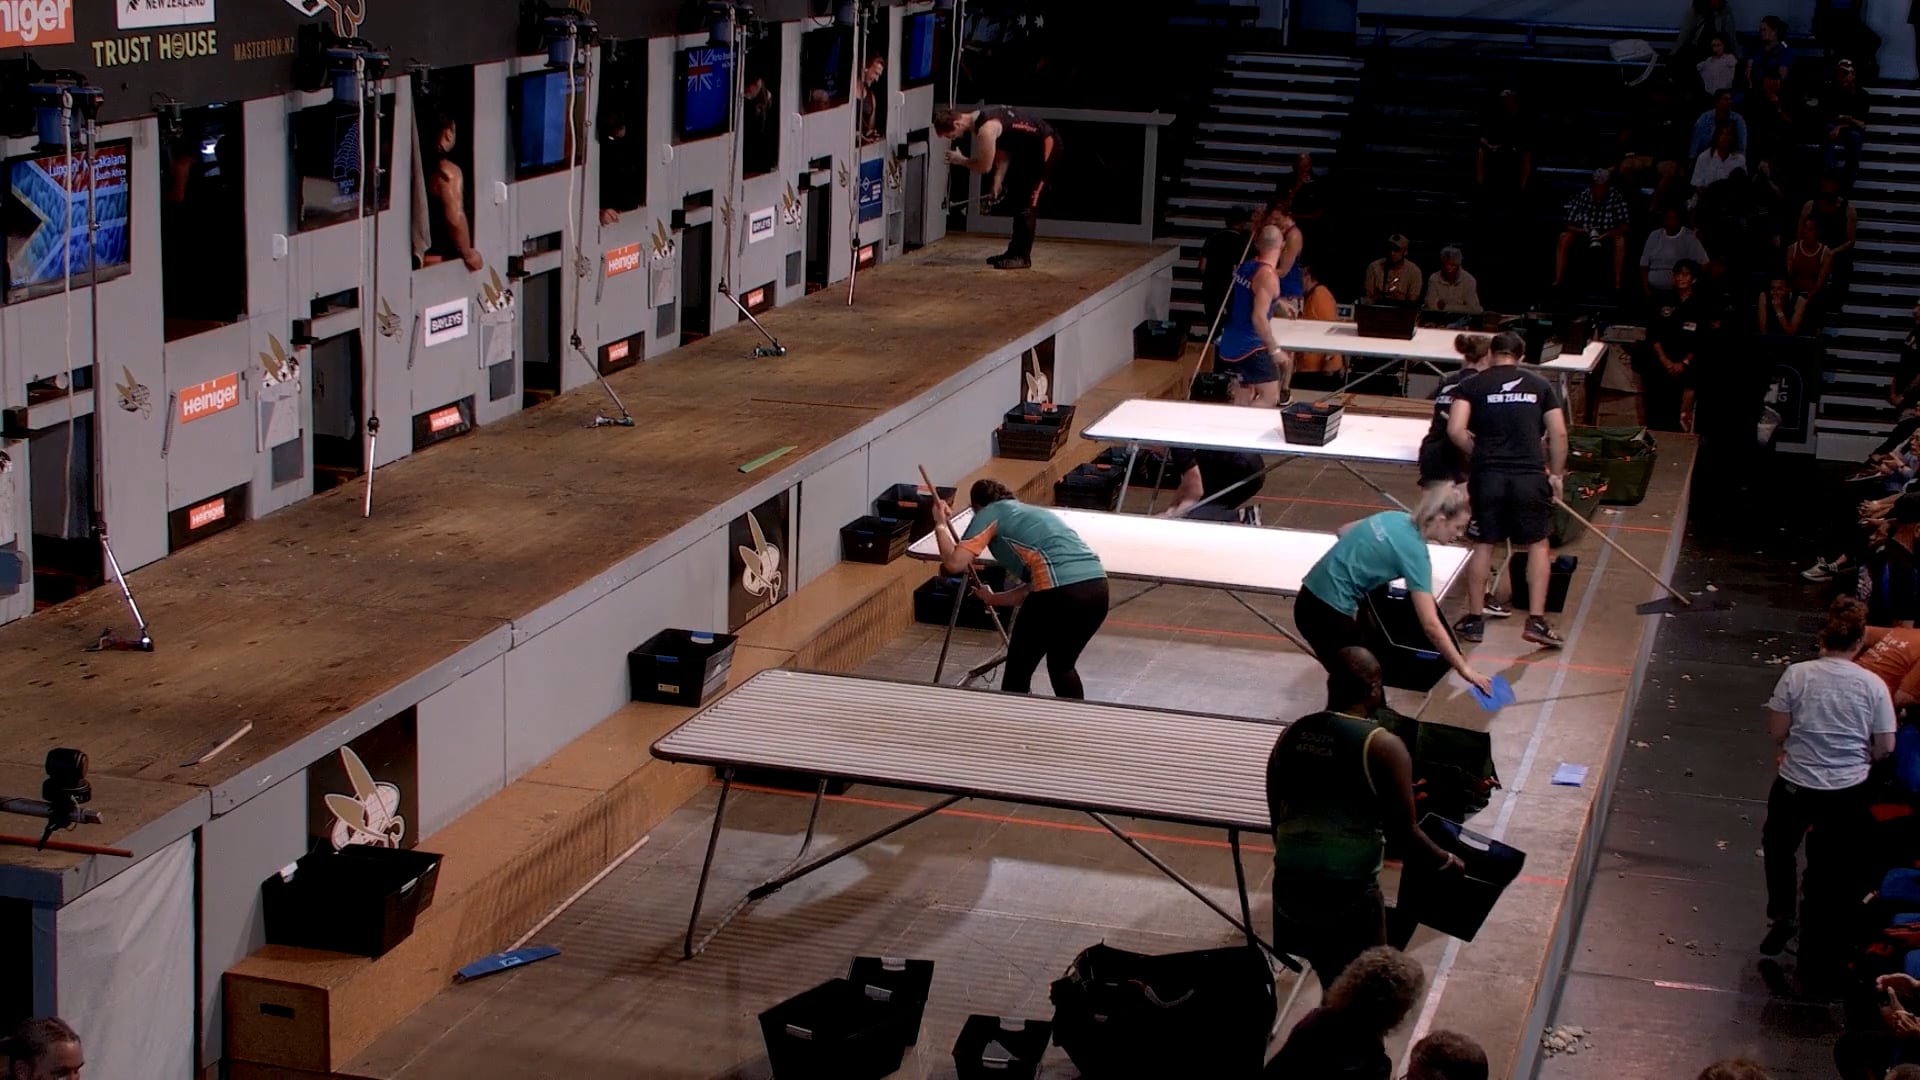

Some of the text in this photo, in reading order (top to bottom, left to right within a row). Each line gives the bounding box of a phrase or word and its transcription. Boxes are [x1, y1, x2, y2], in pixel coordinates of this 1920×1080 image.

[91, 29, 217, 67] TRUST HOUSE
[432, 312, 462, 331] BAYLEYS
[183, 380, 238, 416] Heiniger
[1487, 393, 1537, 404] NEW ZEALAND
[1299, 731, 1334, 745] SOUTH
[1295, 743, 1333, 757] AFRICA
